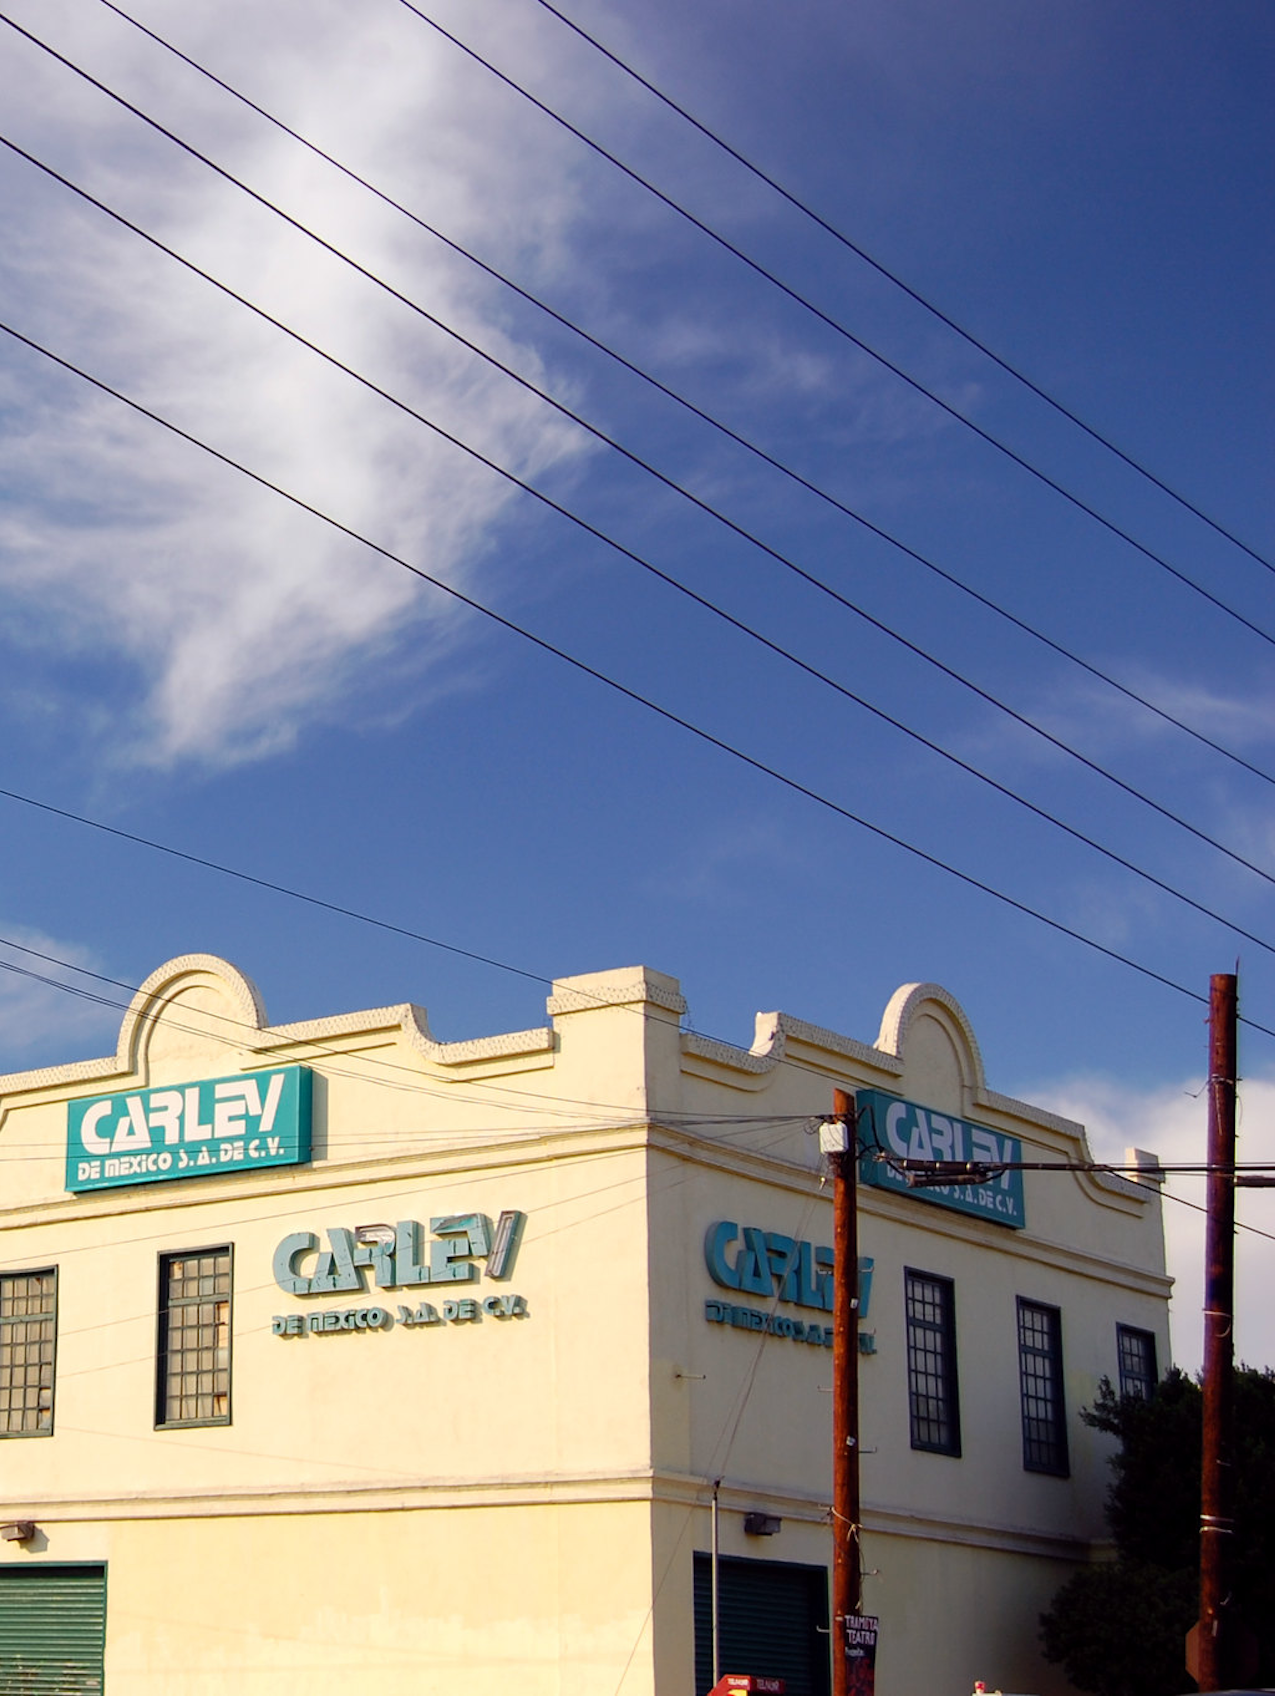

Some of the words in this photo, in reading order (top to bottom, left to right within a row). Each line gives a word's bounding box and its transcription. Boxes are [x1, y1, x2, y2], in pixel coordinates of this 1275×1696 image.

[80, 1073, 285, 1155] CARLEY
[78, 1161, 100, 1181] DE
[105, 1152, 172, 1177] MEXICO
[220, 1140, 244, 1162] DE
[248, 1136, 284, 1159] C.V.
[979, 1189, 994, 1208] DE
[272, 1210, 527, 1295] CARLEY
[272, 1315, 305, 1336] DE
[307, 1307, 389, 1334] MEXICO
[443, 1299, 477, 1321] DE
[846, 1629, 875, 1645] TEATRO
